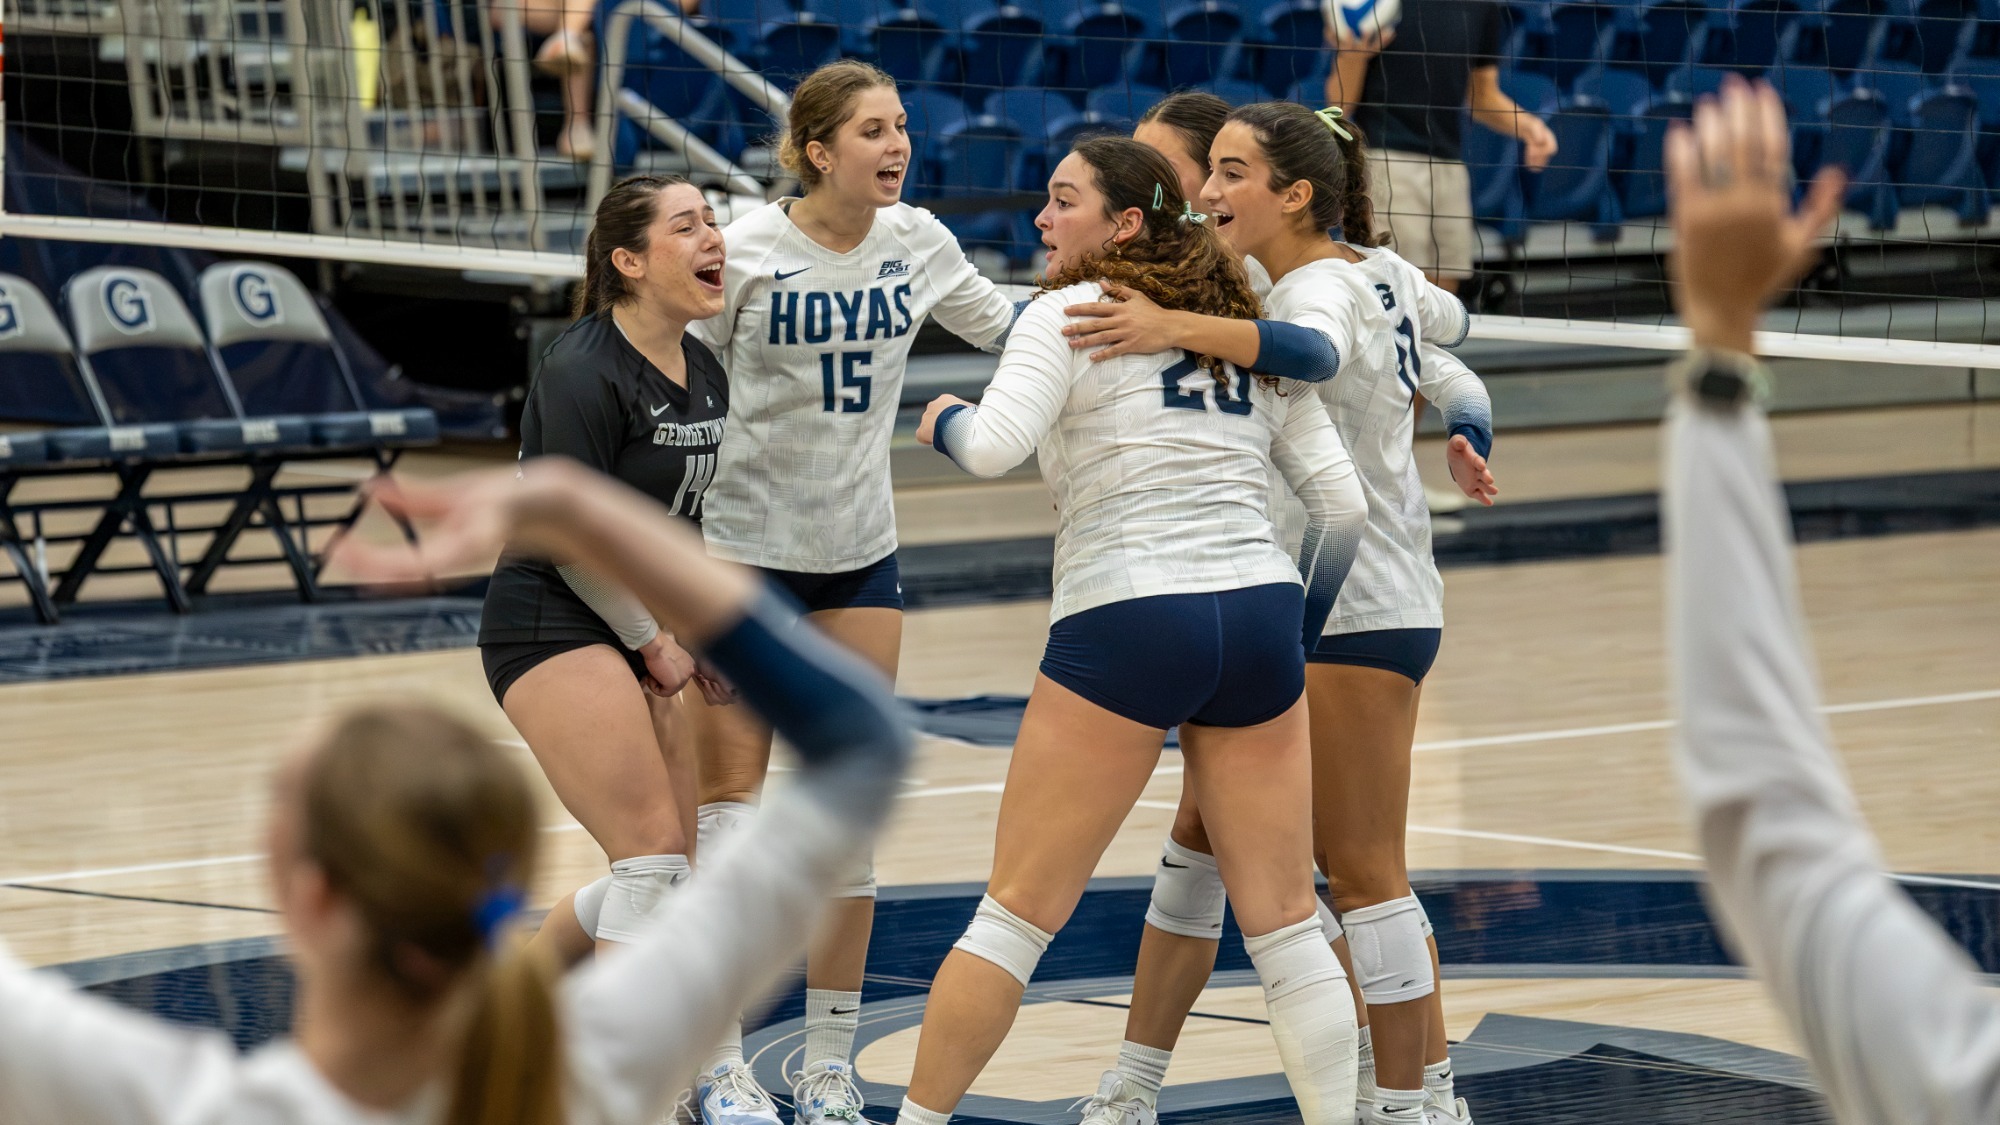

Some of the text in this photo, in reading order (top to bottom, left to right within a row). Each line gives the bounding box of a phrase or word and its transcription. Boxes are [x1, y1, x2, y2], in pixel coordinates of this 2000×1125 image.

[879, 264, 910, 276] EAST
[881, 260, 902, 269] BIG
[106, 278, 149, 328] G
[235, 272, 277, 320] G
[768, 283, 913, 346] HOYAS
[1374, 283, 1396, 312] G
[820, 351, 873, 413] 15
[1161, 349, 1254, 417] 20
[667, 453, 715, 516] 14
